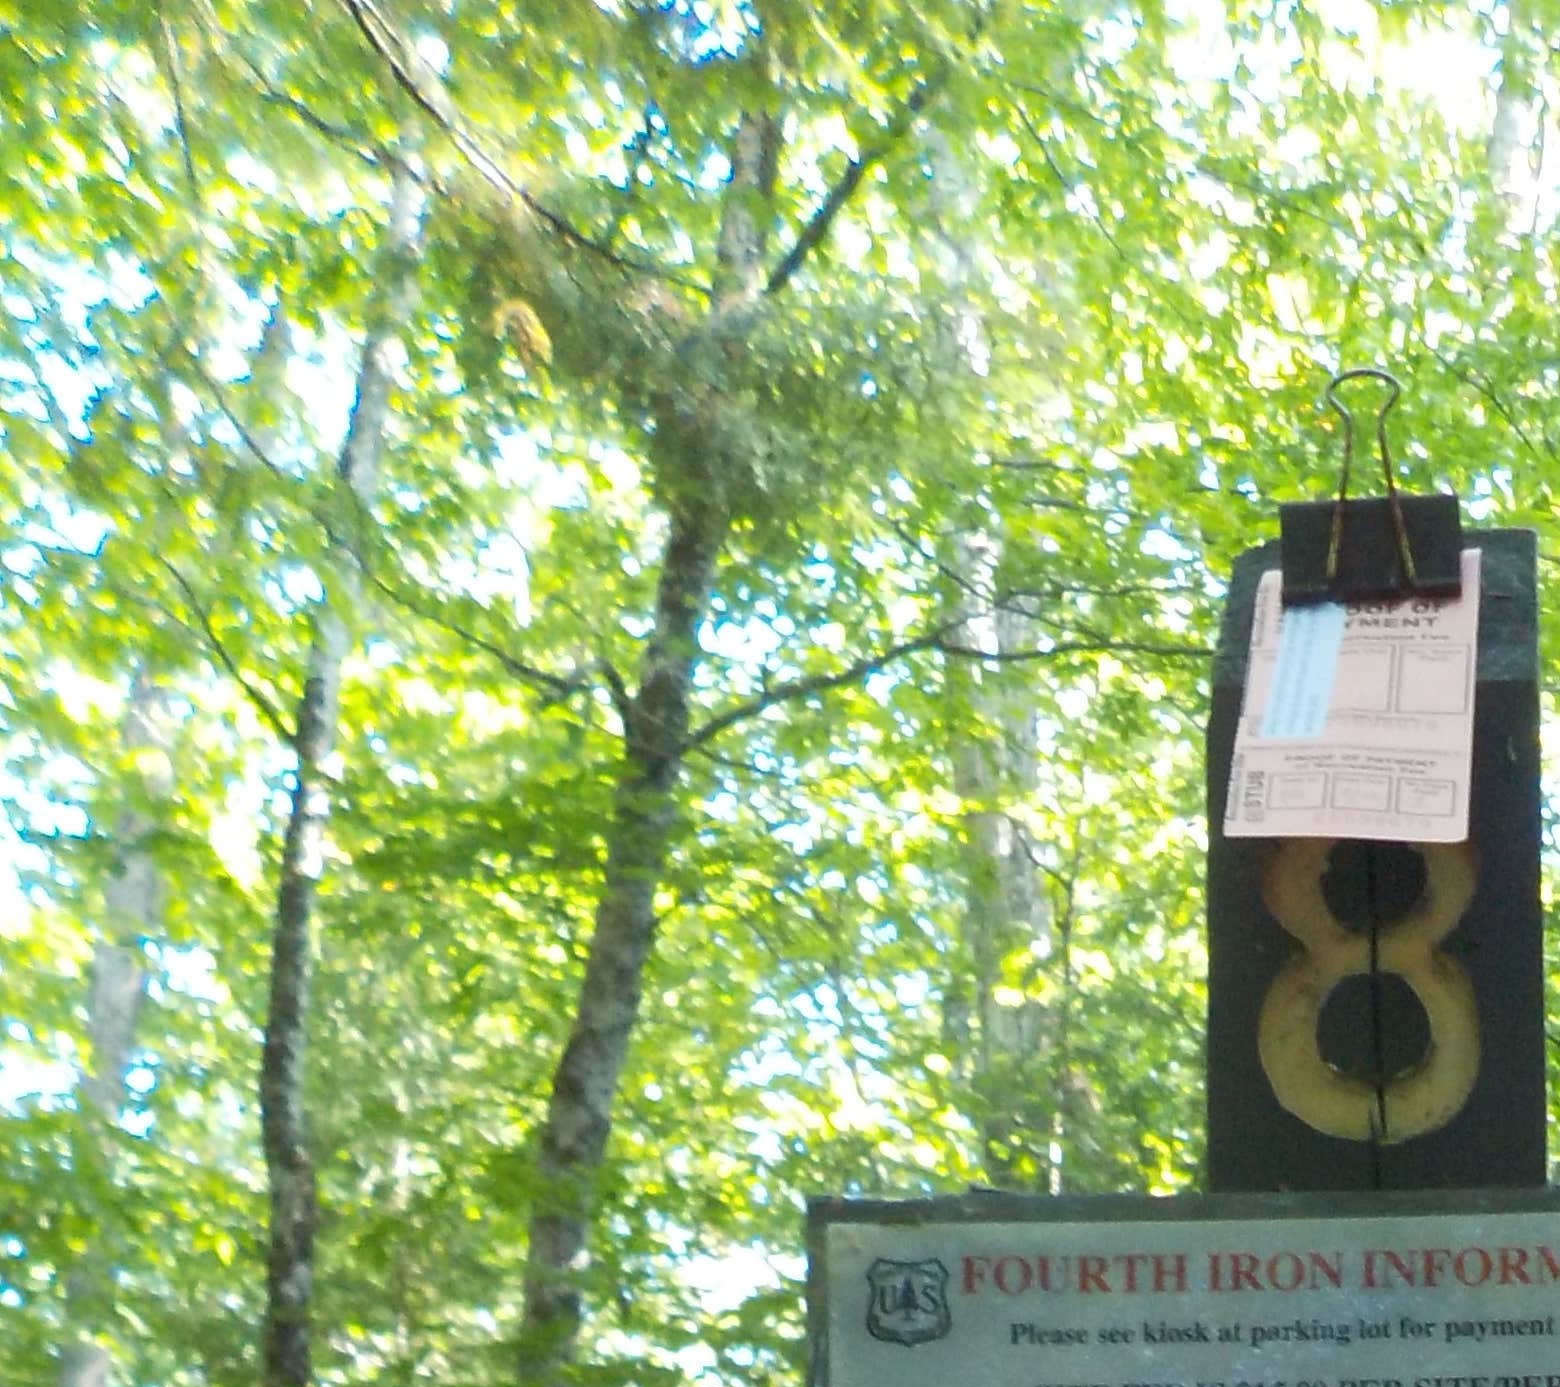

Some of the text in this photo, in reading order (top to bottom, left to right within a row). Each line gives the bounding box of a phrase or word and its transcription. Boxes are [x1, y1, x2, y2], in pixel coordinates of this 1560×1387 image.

[1258, 840, 1481, 1146] 8
[962, 1250, 1189, 1295] FOURTH
[1207, 1250, 1345, 1292] IRON
[1009, 1324, 1089, 1345] Please
[1098, 1328, 1134, 1344] see
[1142, 1322, 1209, 1343] kiosk
[1218, 1323, 1242, 1343] at
[1250, 1320, 1355, 1347] parking
[1354, 1319, 1391, 1339] lot
[1397, 1317, 1436, 1339] for
[1445, 1318, 1555, 1342] payment
